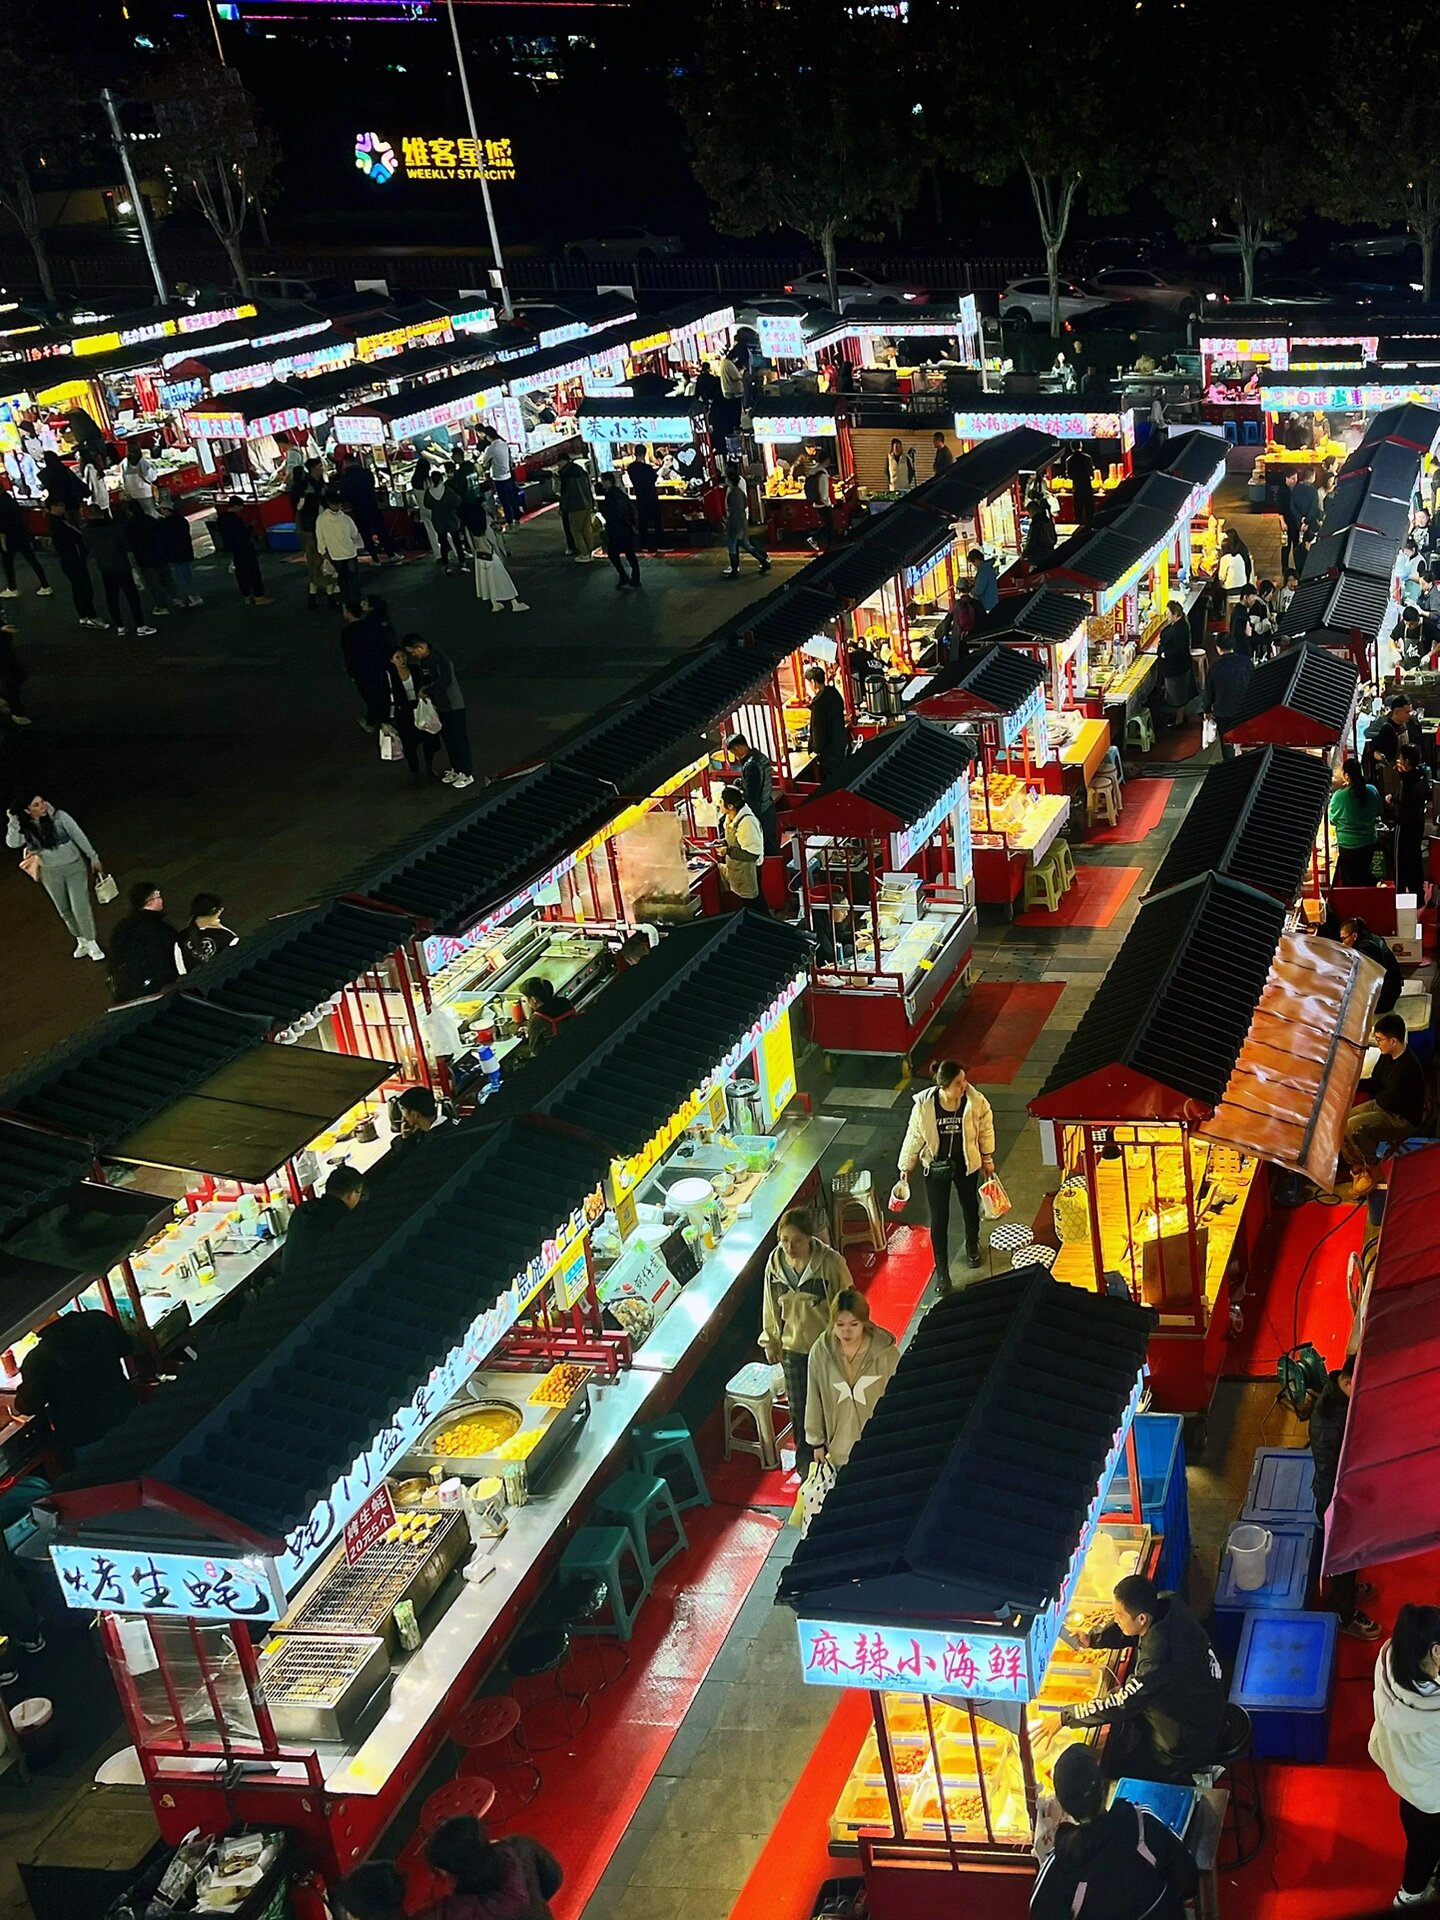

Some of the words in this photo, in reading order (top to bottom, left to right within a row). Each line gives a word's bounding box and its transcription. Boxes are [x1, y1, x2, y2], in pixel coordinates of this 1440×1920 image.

[402, 136, 514, 168] 维客星城
[407, 168, 455, 179] WEEKLY
[346, 1490, 388, 1542] 烤生蚝
[350, 1512, 391, 1559] 20元5个
[63, 1555, 270, 1615] 烤生蚝
[806, 1628, 1027, 1694] 麻辣小海鲜
